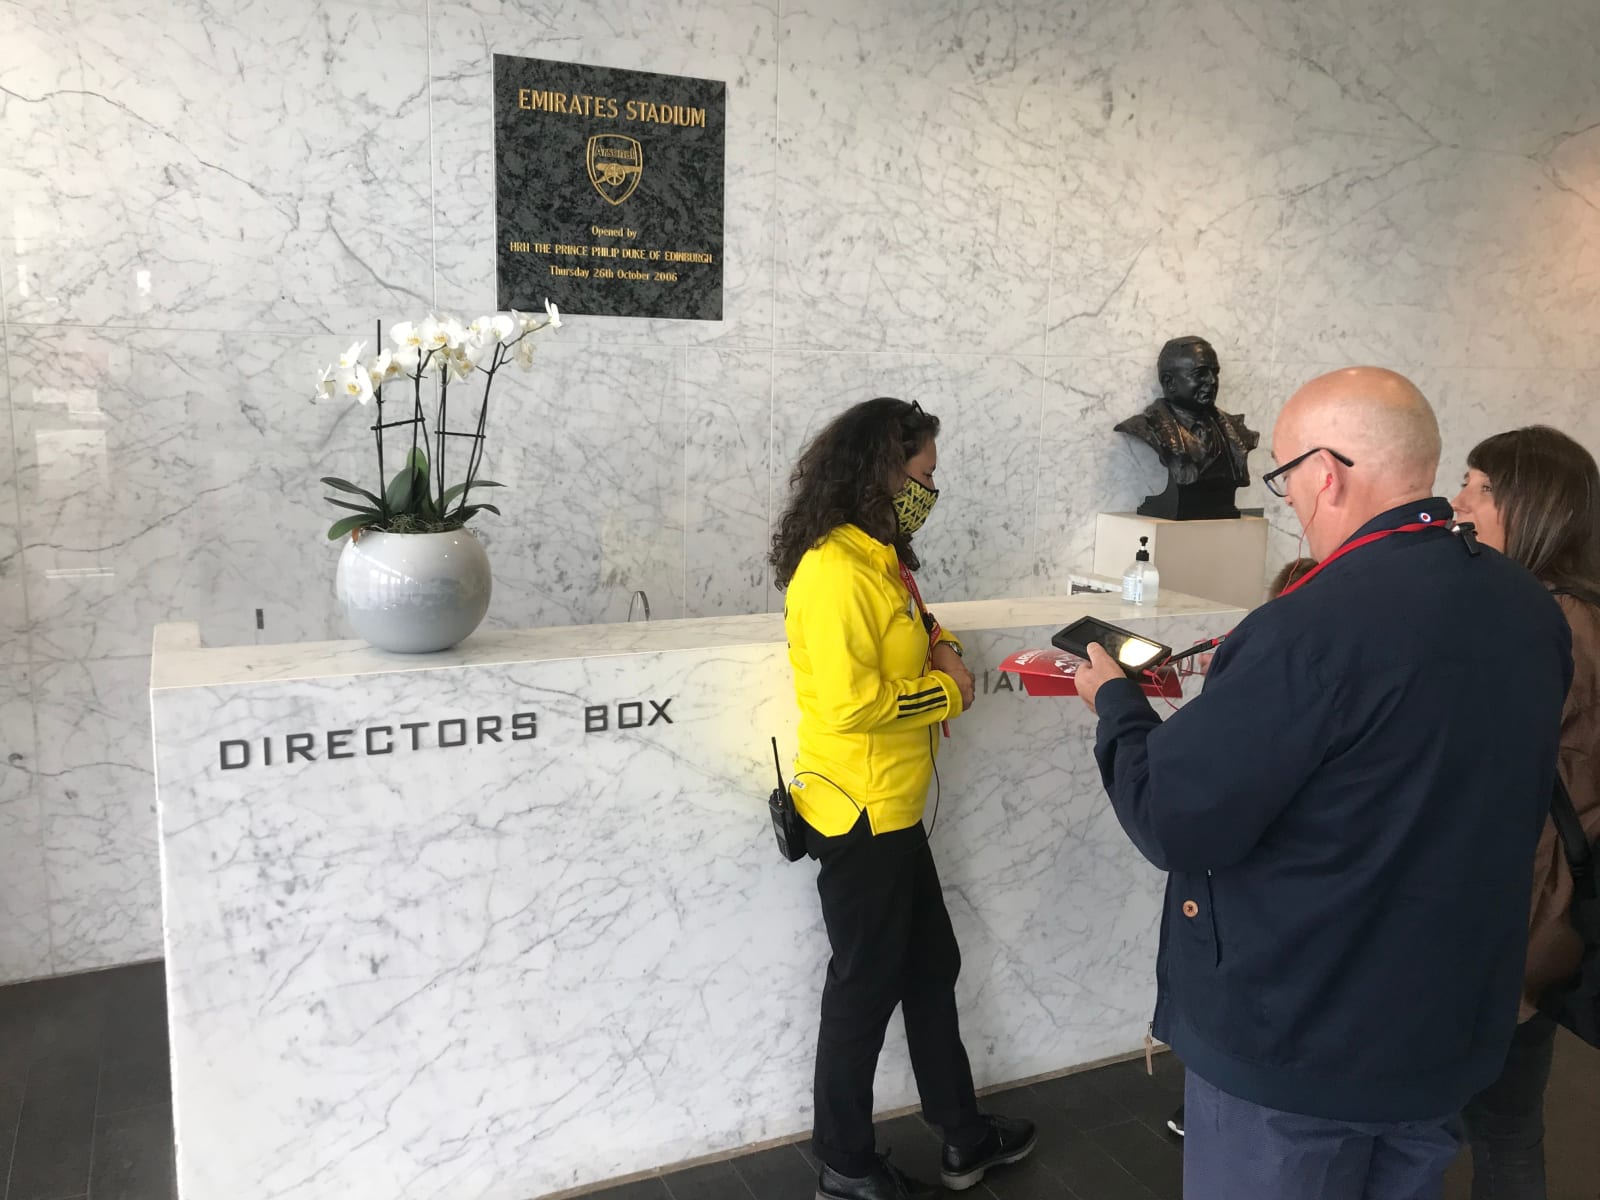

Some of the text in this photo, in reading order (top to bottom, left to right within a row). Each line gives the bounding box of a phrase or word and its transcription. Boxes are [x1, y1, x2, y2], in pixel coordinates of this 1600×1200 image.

[518, 88, 707, 129] EMIRATES STADIUM
[591, 225, 638, 240] Opened by
[509, 241, 713, 264] HRH THE PRINCE PHILIP DUKE OF EDINBURGH
[549, 264, 678, 282] Thursday 26th October 2006
[219, 698, 674, 770] DIRECTORS BOX
